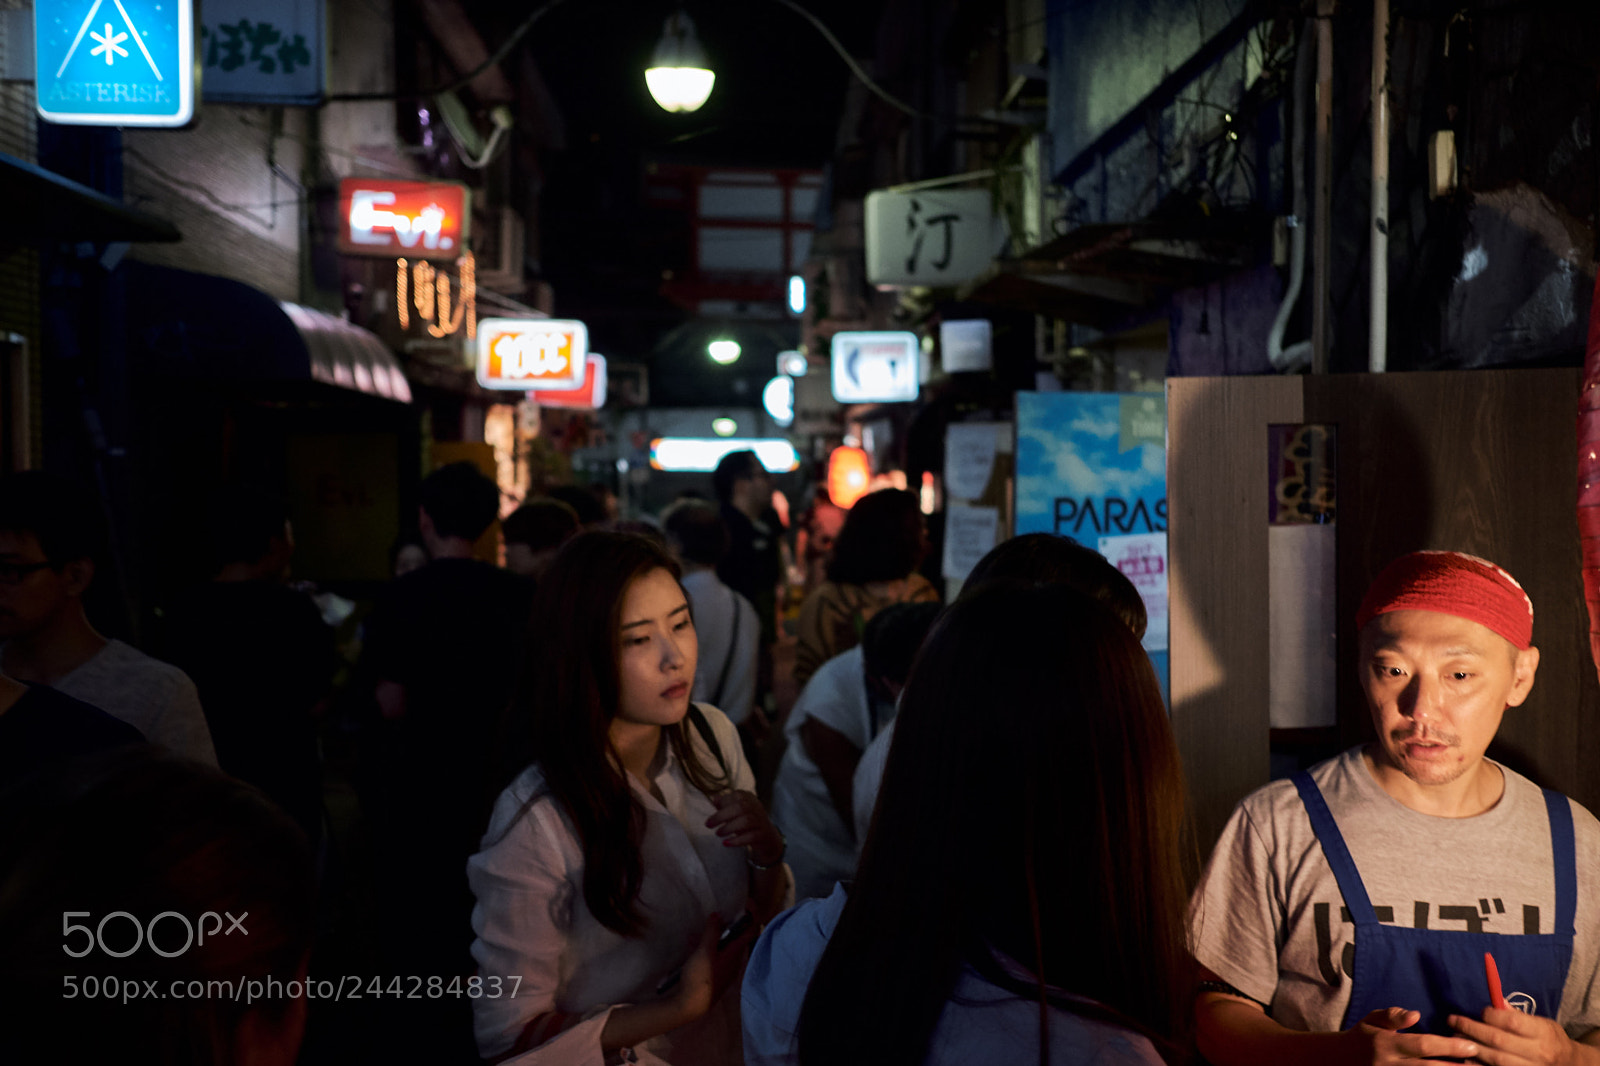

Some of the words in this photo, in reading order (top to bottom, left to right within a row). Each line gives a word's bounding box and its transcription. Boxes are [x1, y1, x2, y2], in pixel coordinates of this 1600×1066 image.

[201, 19, 309, 73] ぼちゃ
[50, 82, 170, 103] ASTERISK
[907, 199, 960, 273] 汀
